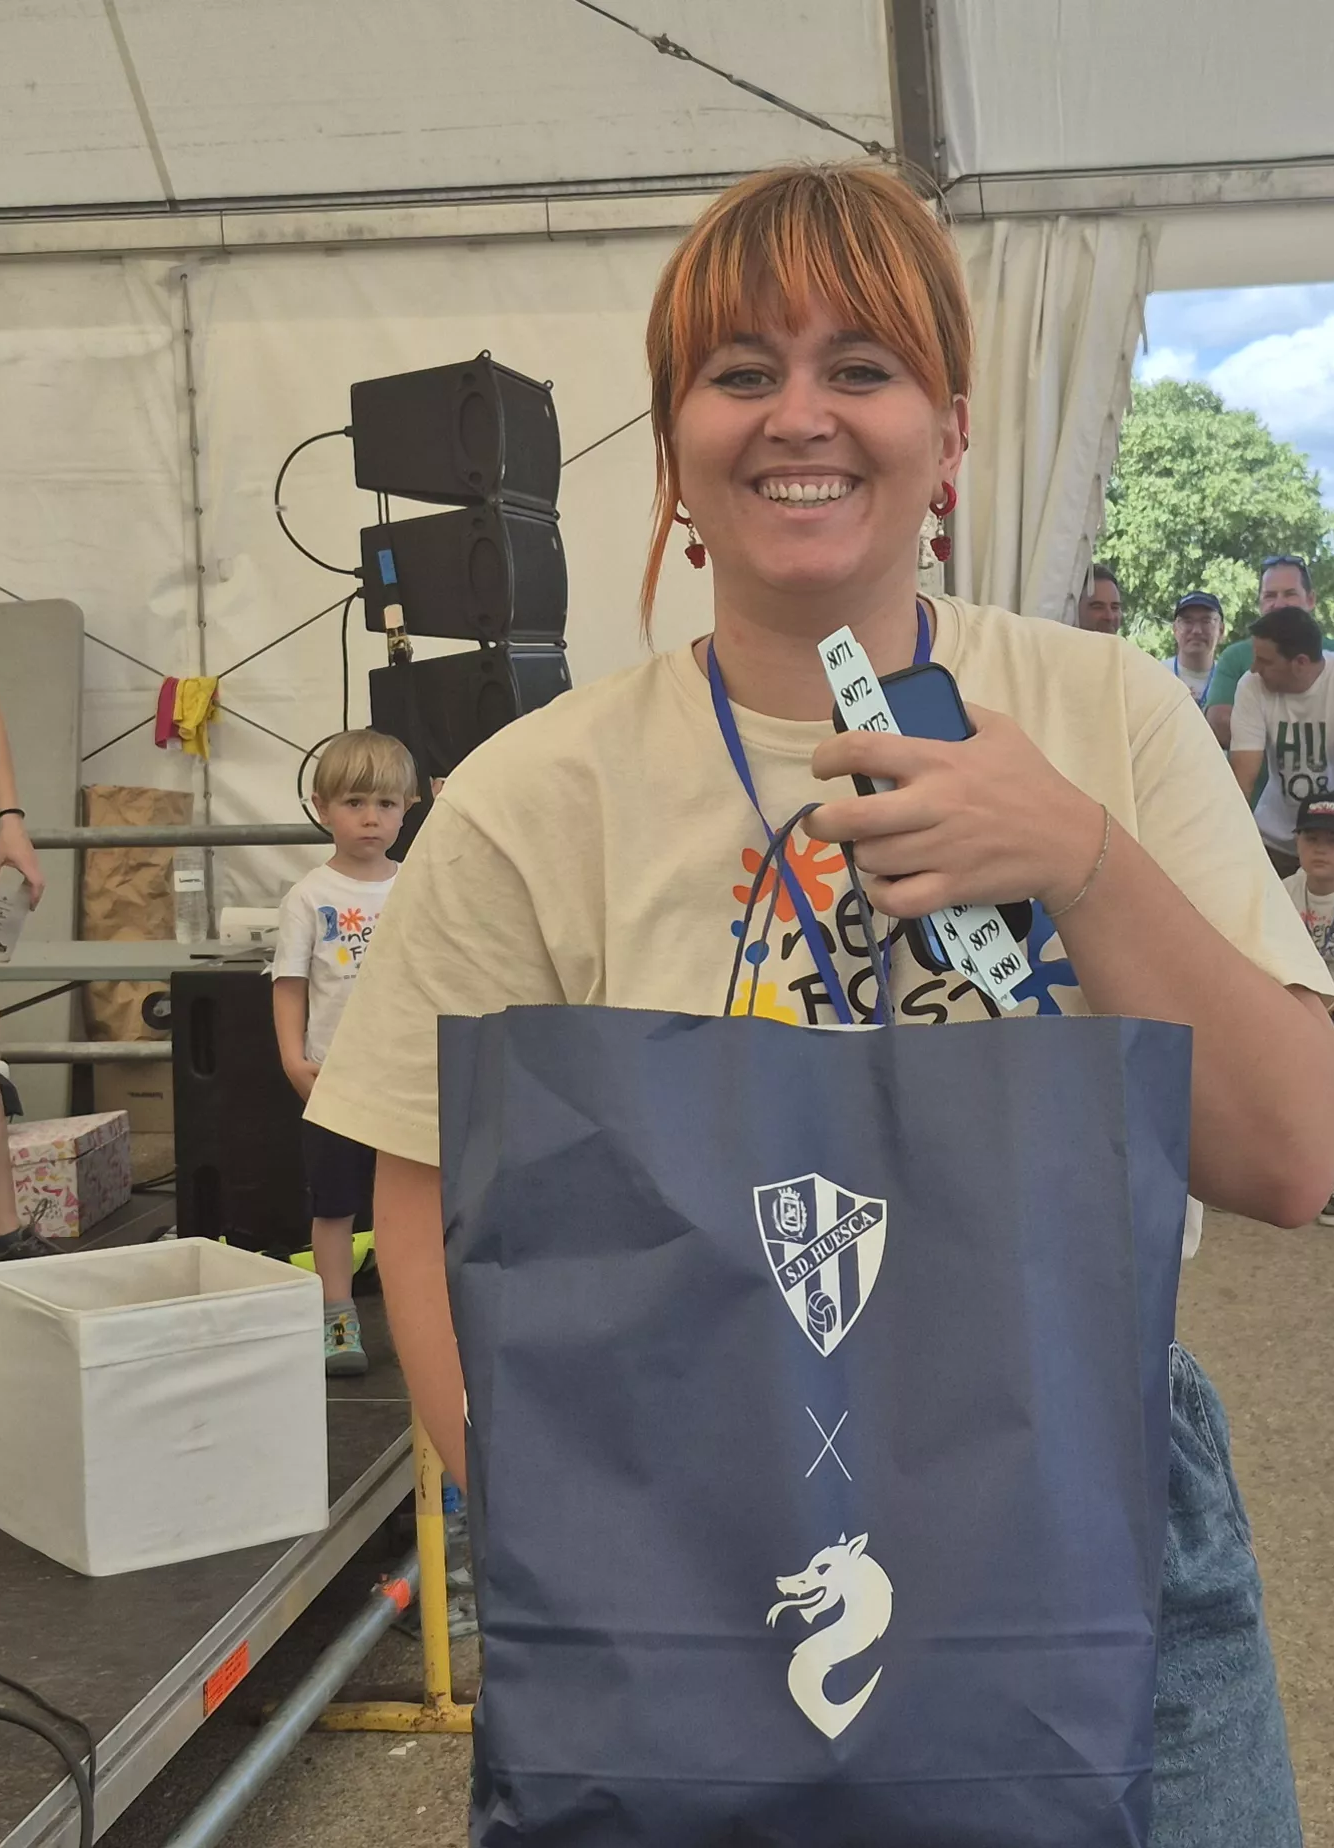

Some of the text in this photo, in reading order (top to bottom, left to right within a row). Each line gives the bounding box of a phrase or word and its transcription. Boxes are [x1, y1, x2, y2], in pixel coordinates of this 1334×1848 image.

[827, 640, 854, 670] 8071
[840, 676, 873, 707] 8072
[1276, 721, 1328, 773] HU
[969, 919, 1000, 951] 8079
[990, 953, 1021, 985] 8080
[810, 1210, 878, 1264] HUESCA
